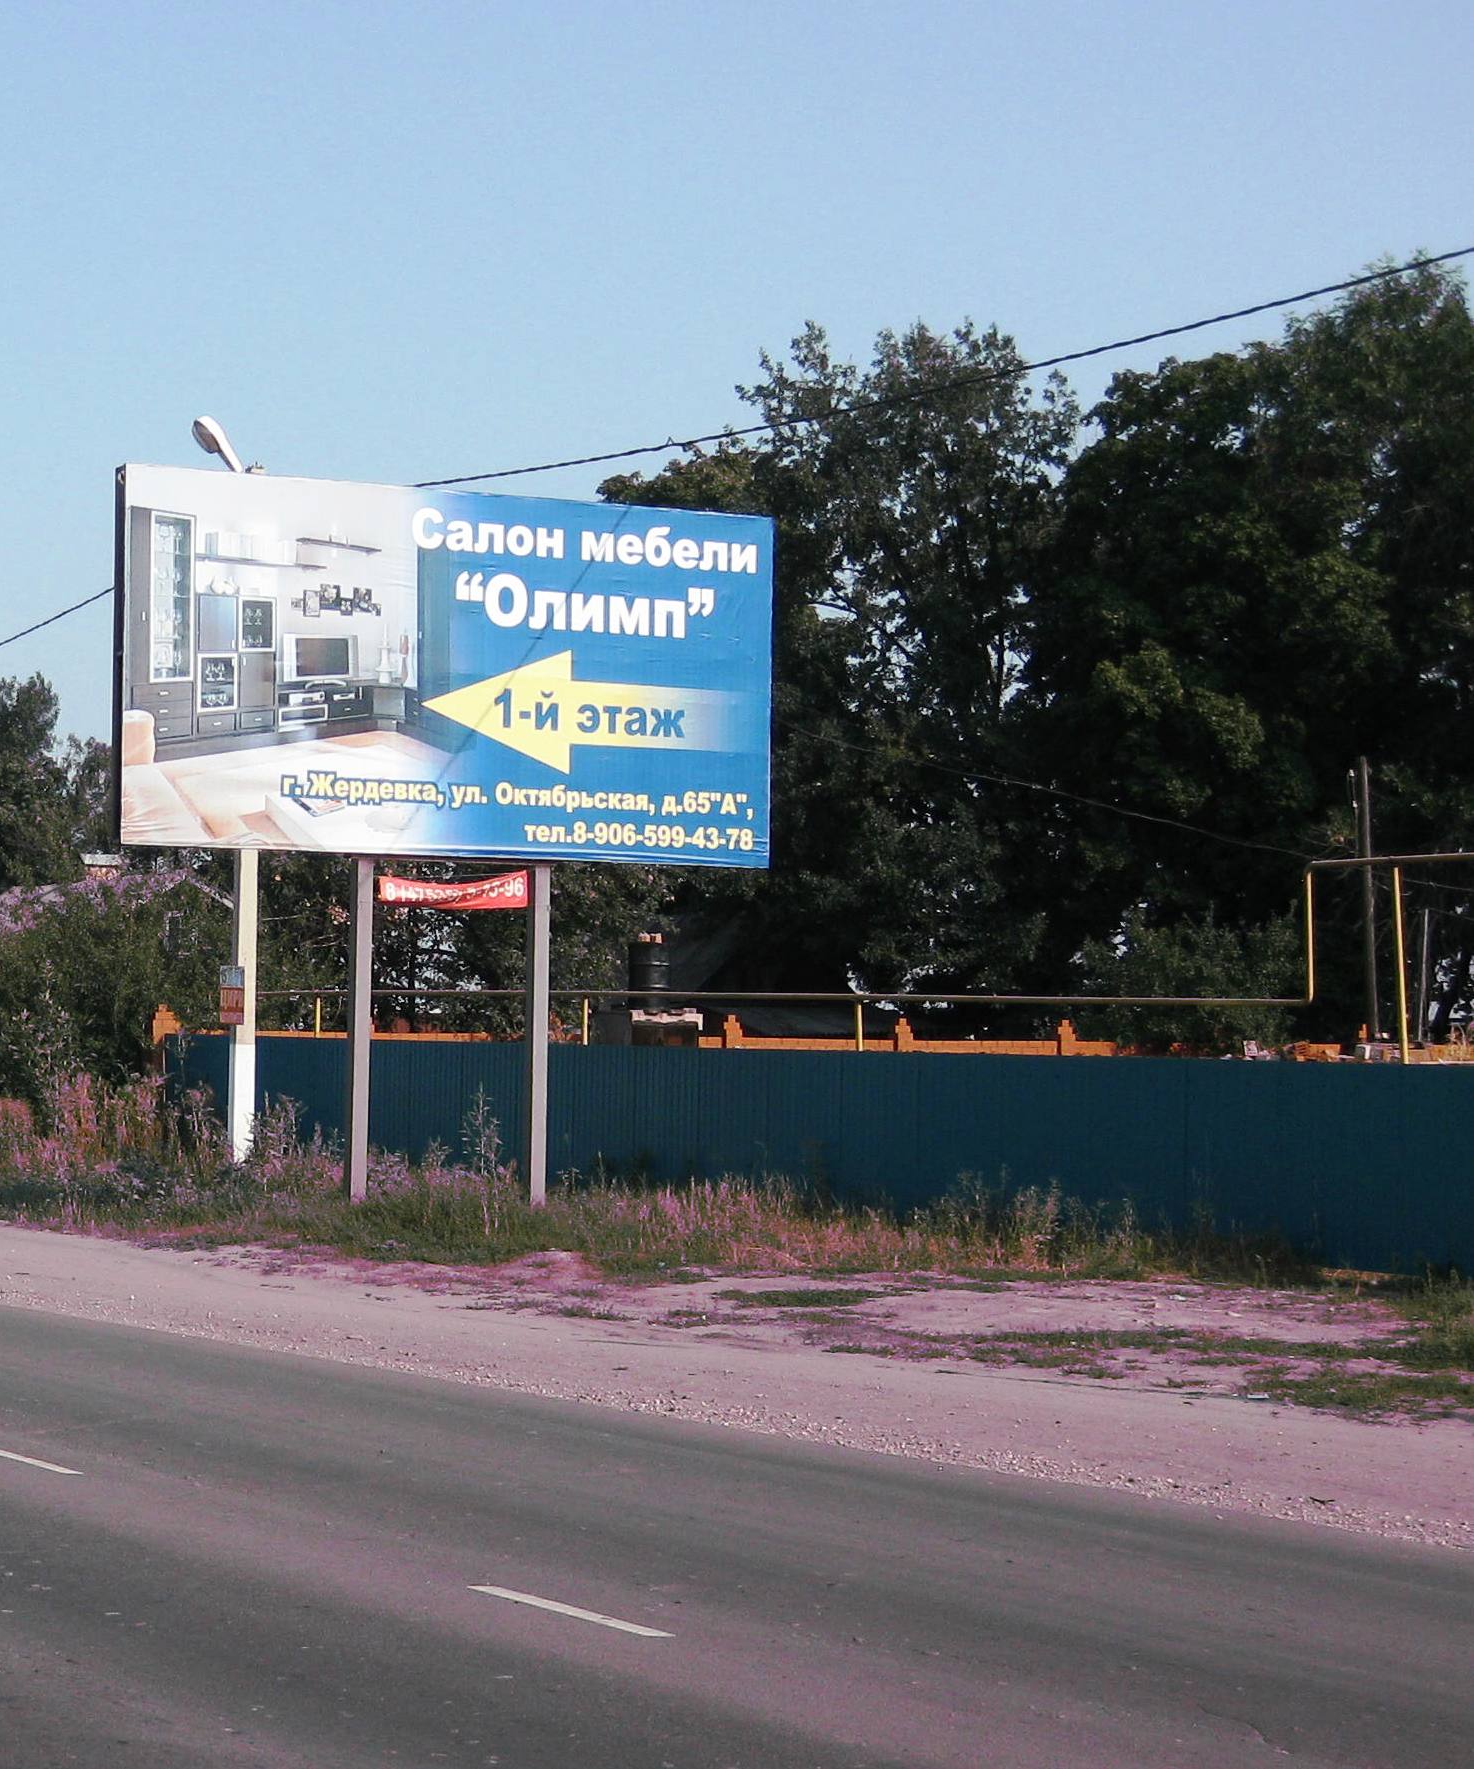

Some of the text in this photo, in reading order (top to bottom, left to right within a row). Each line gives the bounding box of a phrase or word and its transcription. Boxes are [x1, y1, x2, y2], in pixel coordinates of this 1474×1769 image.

[410, 507, 759, 574] Салон мебели
[493, 688, 686, 739] 1-й этаж
[306, 770, 446, 810] Жердевка,
[449, 783, 488, 810] ул.
[494, 781, 656, 817] Октябрьская,
[523, 821, 755, 852] тел.8-906-599-43-78
